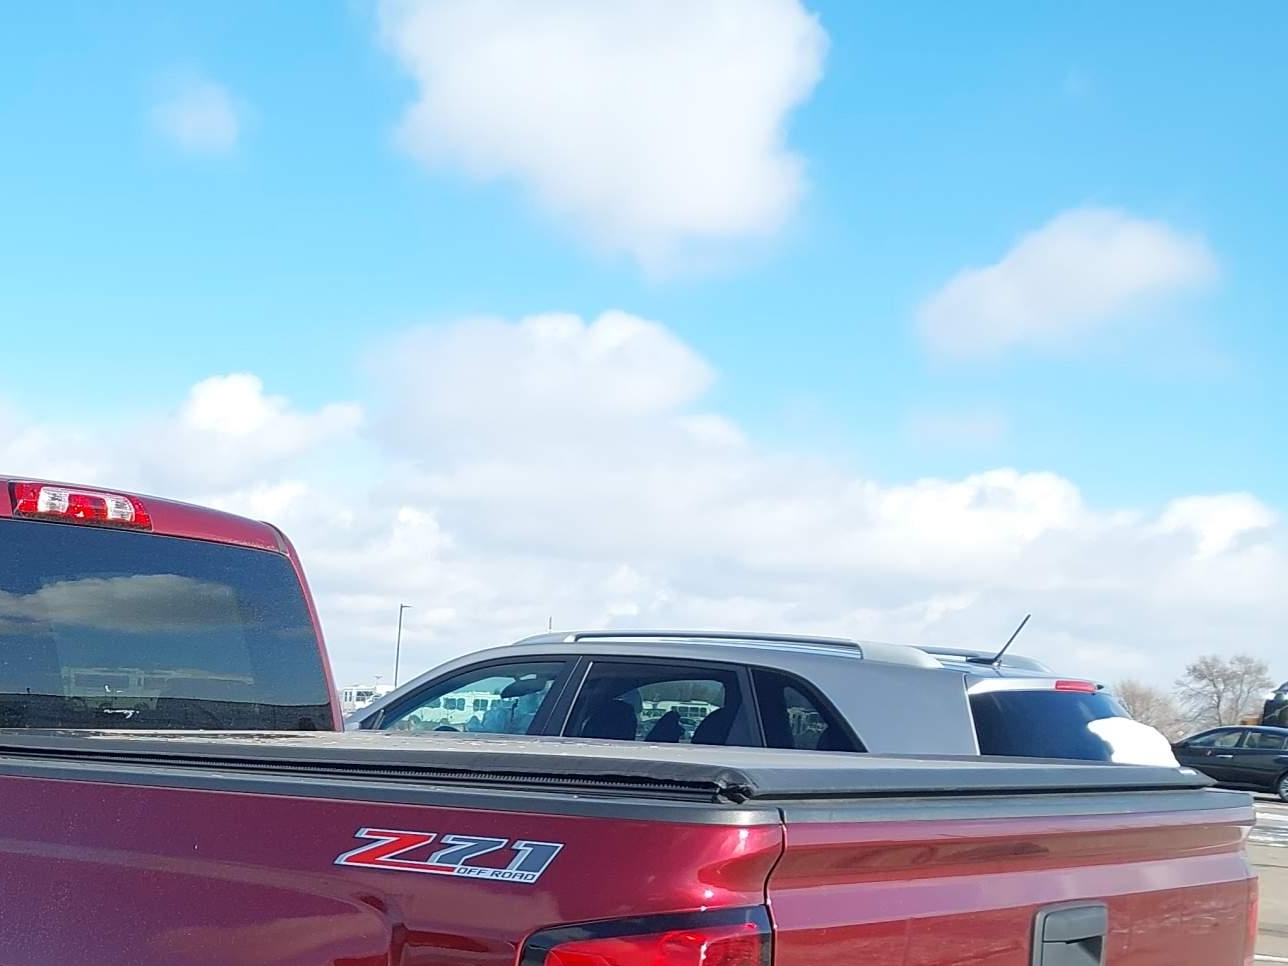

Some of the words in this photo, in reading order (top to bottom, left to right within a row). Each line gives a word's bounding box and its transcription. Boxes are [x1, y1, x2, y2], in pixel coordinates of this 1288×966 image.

[333, 827, 565, 876] Z71
[456, 866, 490, 877] OFF
[490, 869, 537, 882] ROAD
